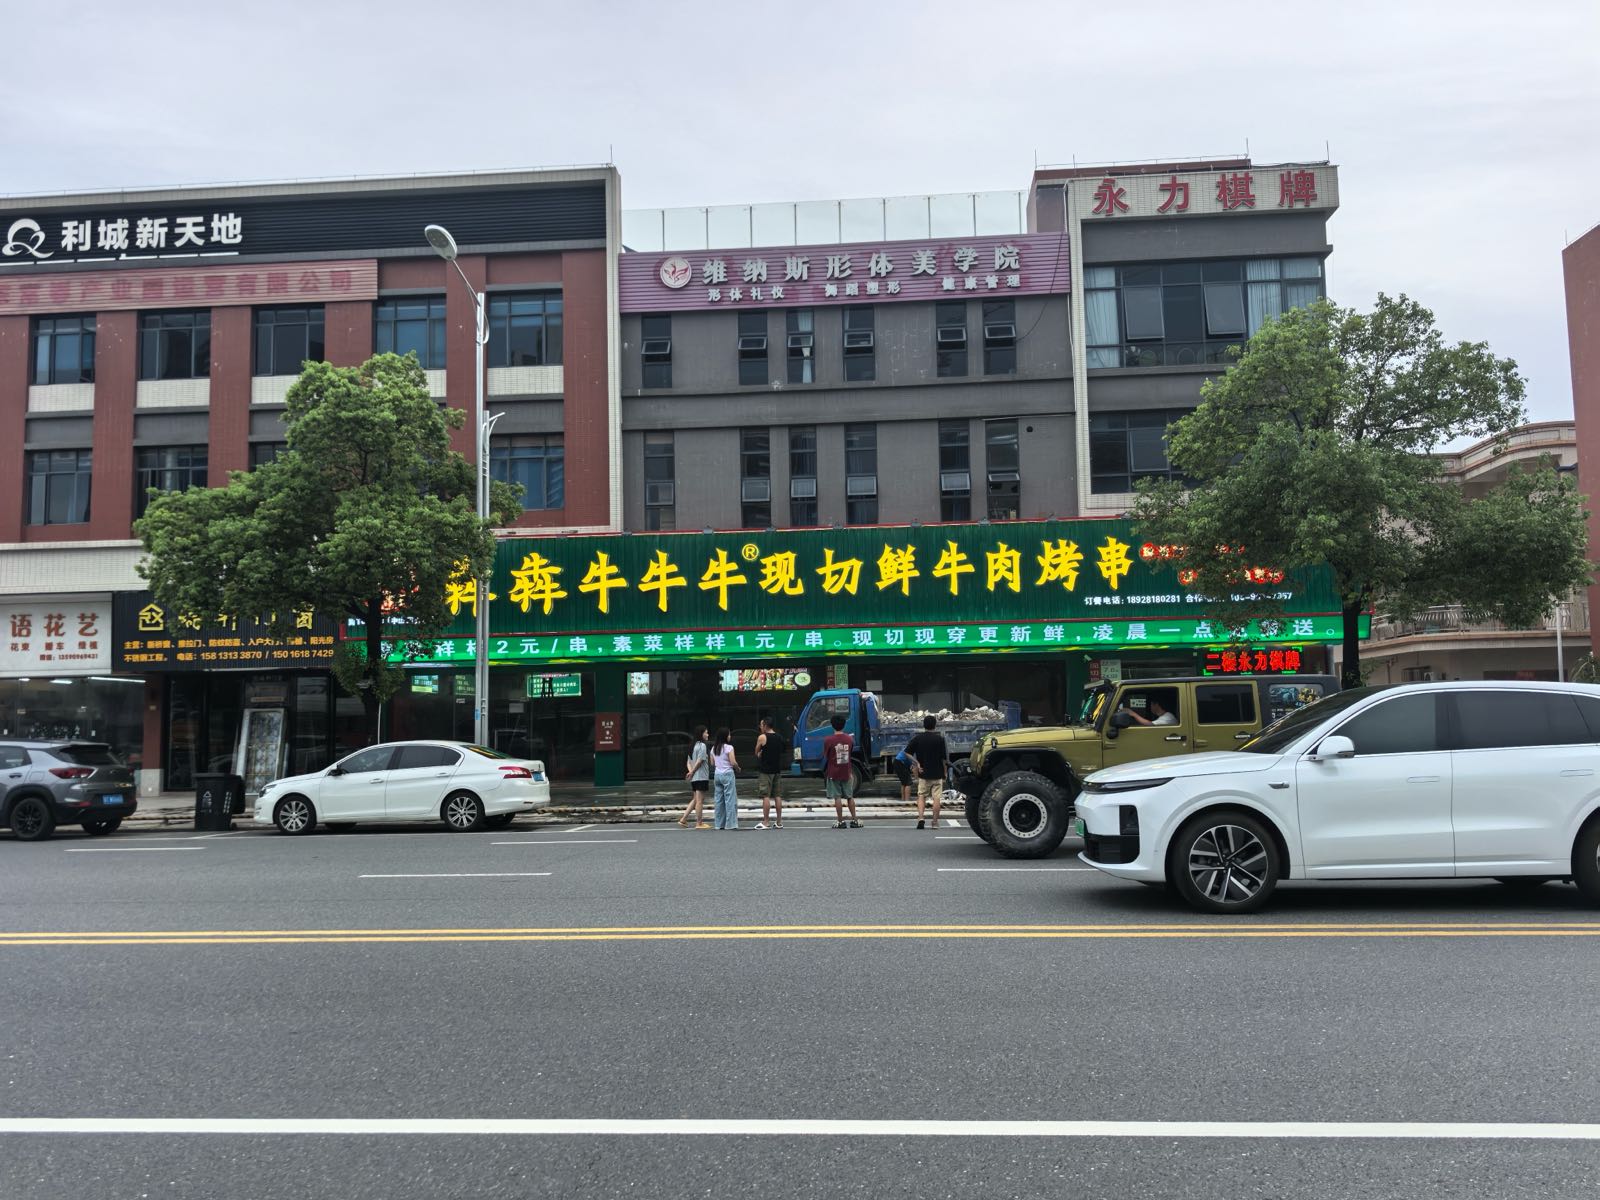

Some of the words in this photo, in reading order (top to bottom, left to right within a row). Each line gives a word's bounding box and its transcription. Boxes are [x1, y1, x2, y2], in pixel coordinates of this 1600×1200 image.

[1092, 169, 1318, 216] 永力棋牌
[61, 213, 243, 251] 利城新天地
[703, 245, 1020, 285] 维纳斯形体美学院
[708, 286, 785, 302] 形体礼仪
